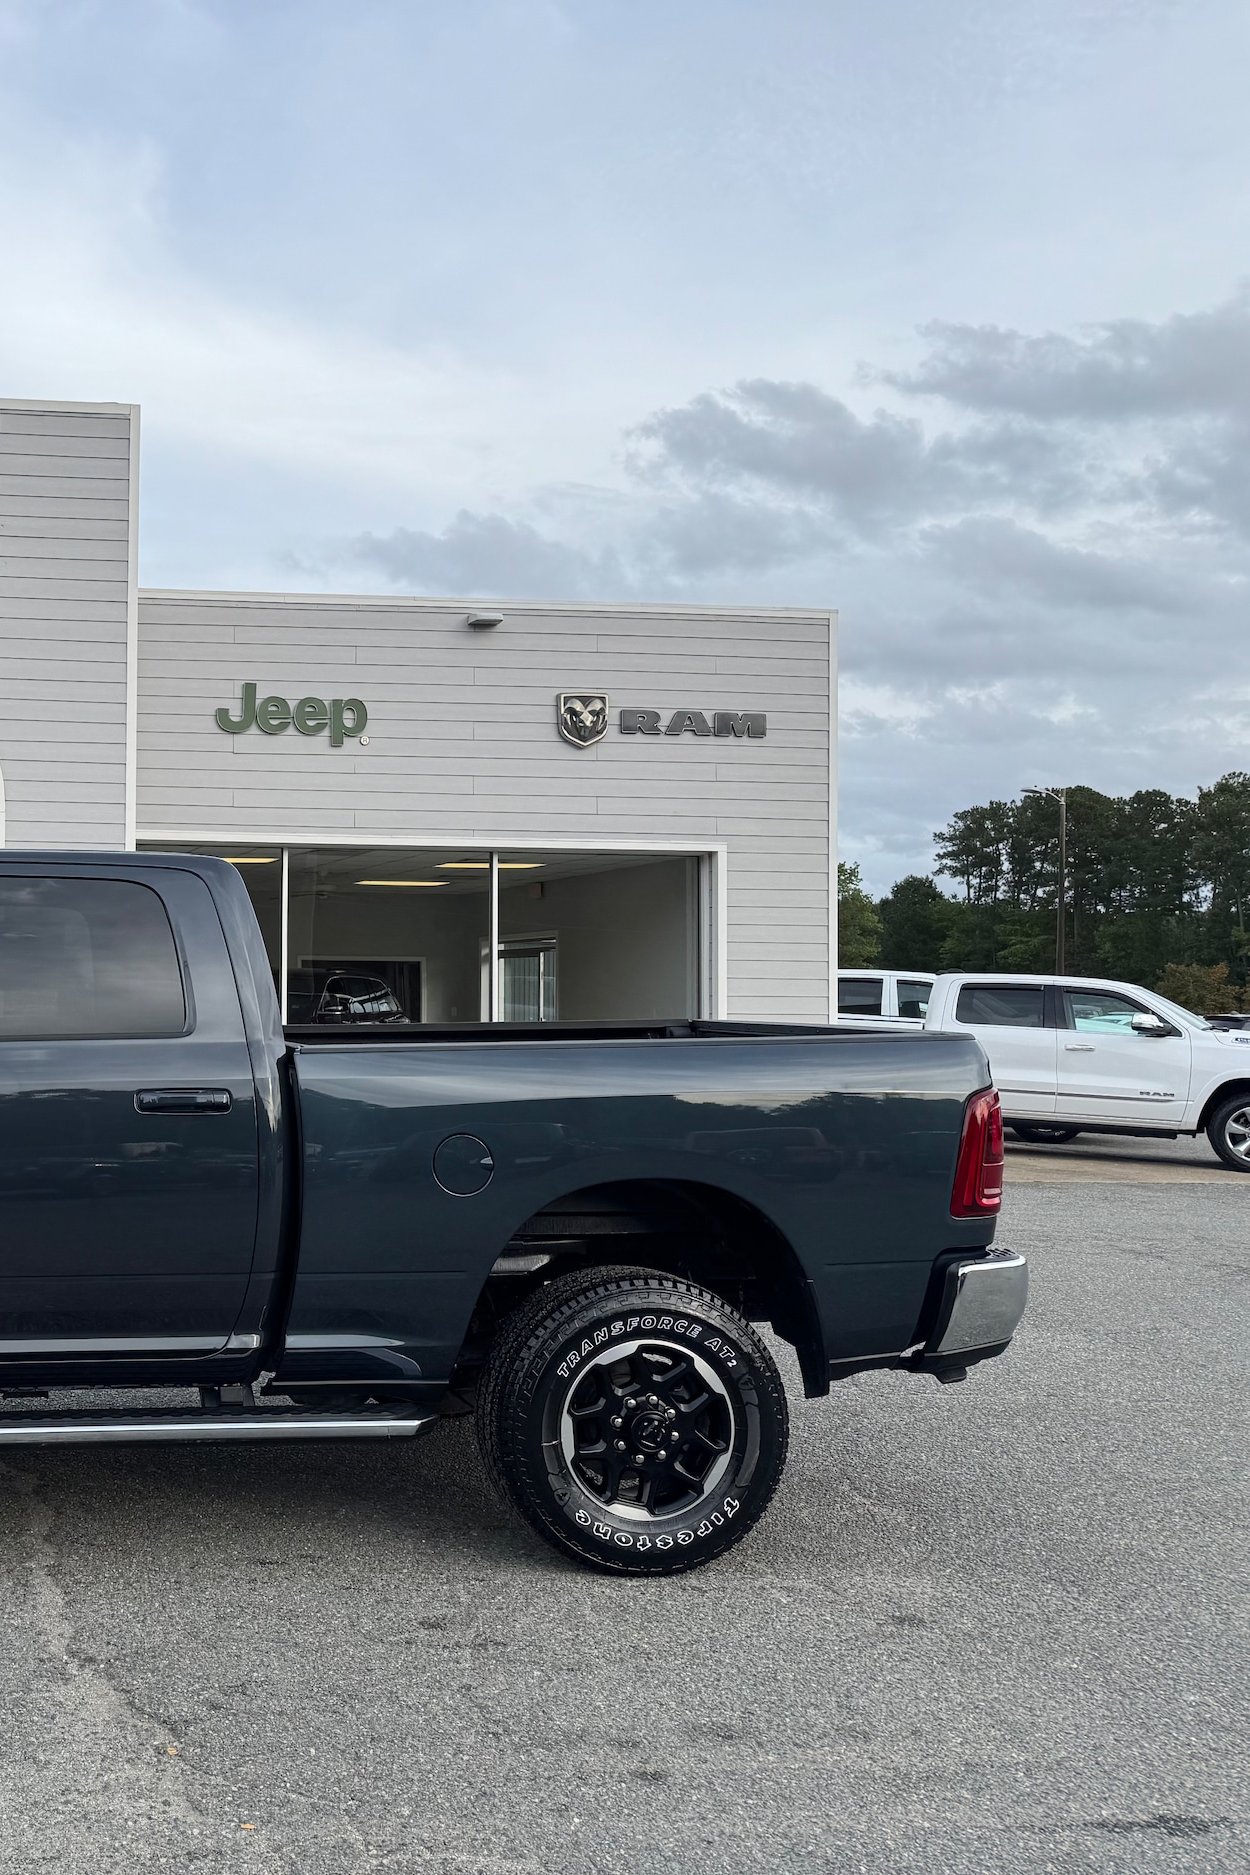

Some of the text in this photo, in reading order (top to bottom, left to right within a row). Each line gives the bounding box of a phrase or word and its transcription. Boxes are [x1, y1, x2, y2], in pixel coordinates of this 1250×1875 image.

[216, 682, 368, 747] Jeep
[620, 709, 767, 738] RAM
[556, 1315, 702, 1378] TRANSFORCE
[575, 1497, 740, 1551] Firestone
